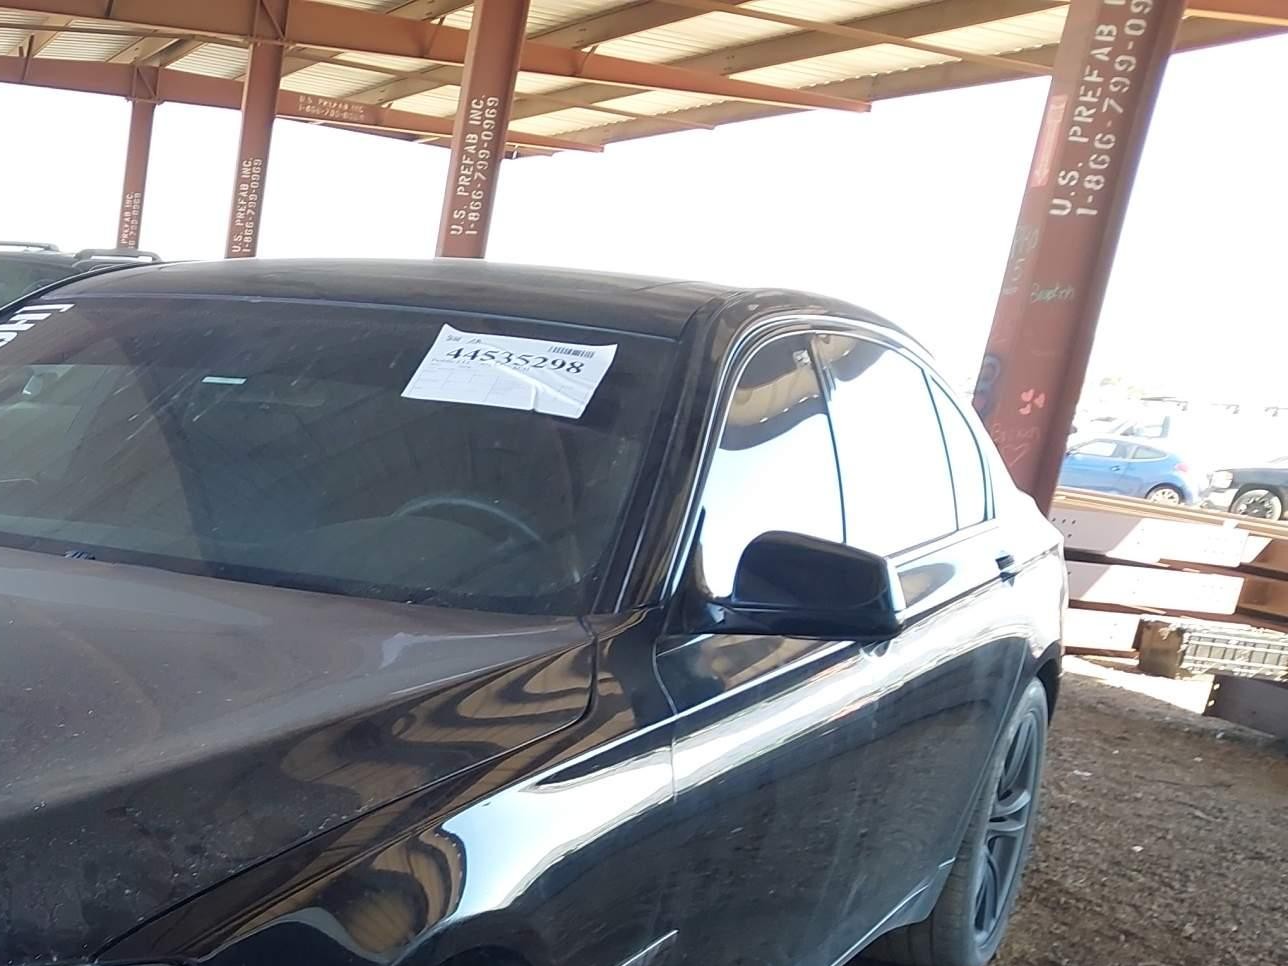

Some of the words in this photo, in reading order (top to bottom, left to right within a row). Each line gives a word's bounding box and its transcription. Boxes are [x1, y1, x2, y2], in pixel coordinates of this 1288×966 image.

[468, 95, 486, 125] INC.
[1048, 162, 1083, 216] U.S.
[1068, 23, 1118, 143] PREFAB
[241, 157, 253, 178] INC.
[456, 133, 479, 196] PREFAB
[465, 96, 500, 235] 1-866-799-0969
[234, 183, 250, 226] PREFAB
[450, 205, 467, 235] U.S.
[231, 231, 244, 253] U.S.
[446, 347, 585, 375] 44535298
